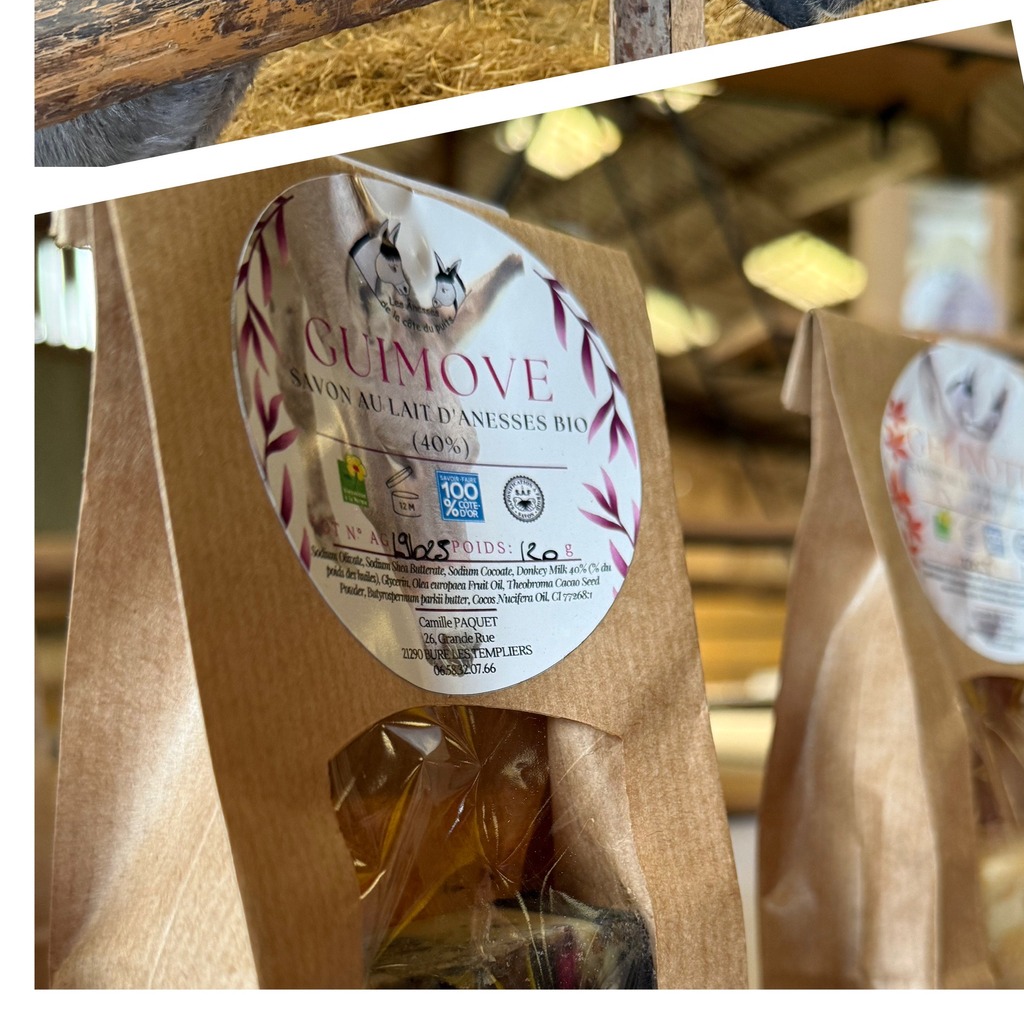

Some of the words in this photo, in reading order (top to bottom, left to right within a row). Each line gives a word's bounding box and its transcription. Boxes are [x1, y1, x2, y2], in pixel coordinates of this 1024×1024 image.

[423, 323, 434, 333] du
[305, 317, 553, 402] GUIMOVE
[289, 368, 352, 404] SAVON
[358, 392, 383, 413] AU
[390, 398, 431, 422] LAIT
[438, 406, 547, 432] D'ANESSES
[554, 417, 588, 434] BIO
[412, 431, 470, 460] (40%)
[441, 481, 478, 500] 100
[451, 540, 512, 554] POIDS:
[521, 541, 558, 561] 120
[565, 543, 573, 557] g
[365, 556, 391, 571] Sodium
[392, 560, 409, 573] Shea
[410, 564, 446, 576] Butterate,
[448, 565, 479, 576] Sodium
[480, 566, 514, 576] Cocoate,
[516, 565, 547, 577] Donkey
[549, 564, 568, 574] Milk
[569, 563, 587, 575] 40%
[412, 576, 429, 589] Olea
[430, 580, 466, 592] europaea
[468, 580, 488, 590] Fruit
[490, 579, 505, 591] Oil,
[507, 578, 553, 590] Theobroma
[555, 578, 580, 587] Cacao
[582, 576, 600, 586] Seed
[421, 593, 443, 605] parkii
[444, 593, 470, 605] butter,
[472, 594, 495, 604] Cocos
[496, 592, 533, 605] Nucifera
[551, 591, 561, 601] CI
[419, 616, 452, 628] Camille
[453, 616, 498, 631] PAQUET
[424, 632, 437, 645] 26,
[438, 632, 473, 644] Grande
[474, 633, 495, 643] Rue
[402, 648, 423, 660] 21290
[424, 648, 449, 660] BURE
[452, 648, 470, 659] LES
[472, 645, 533, 658] TEMPLIERS
